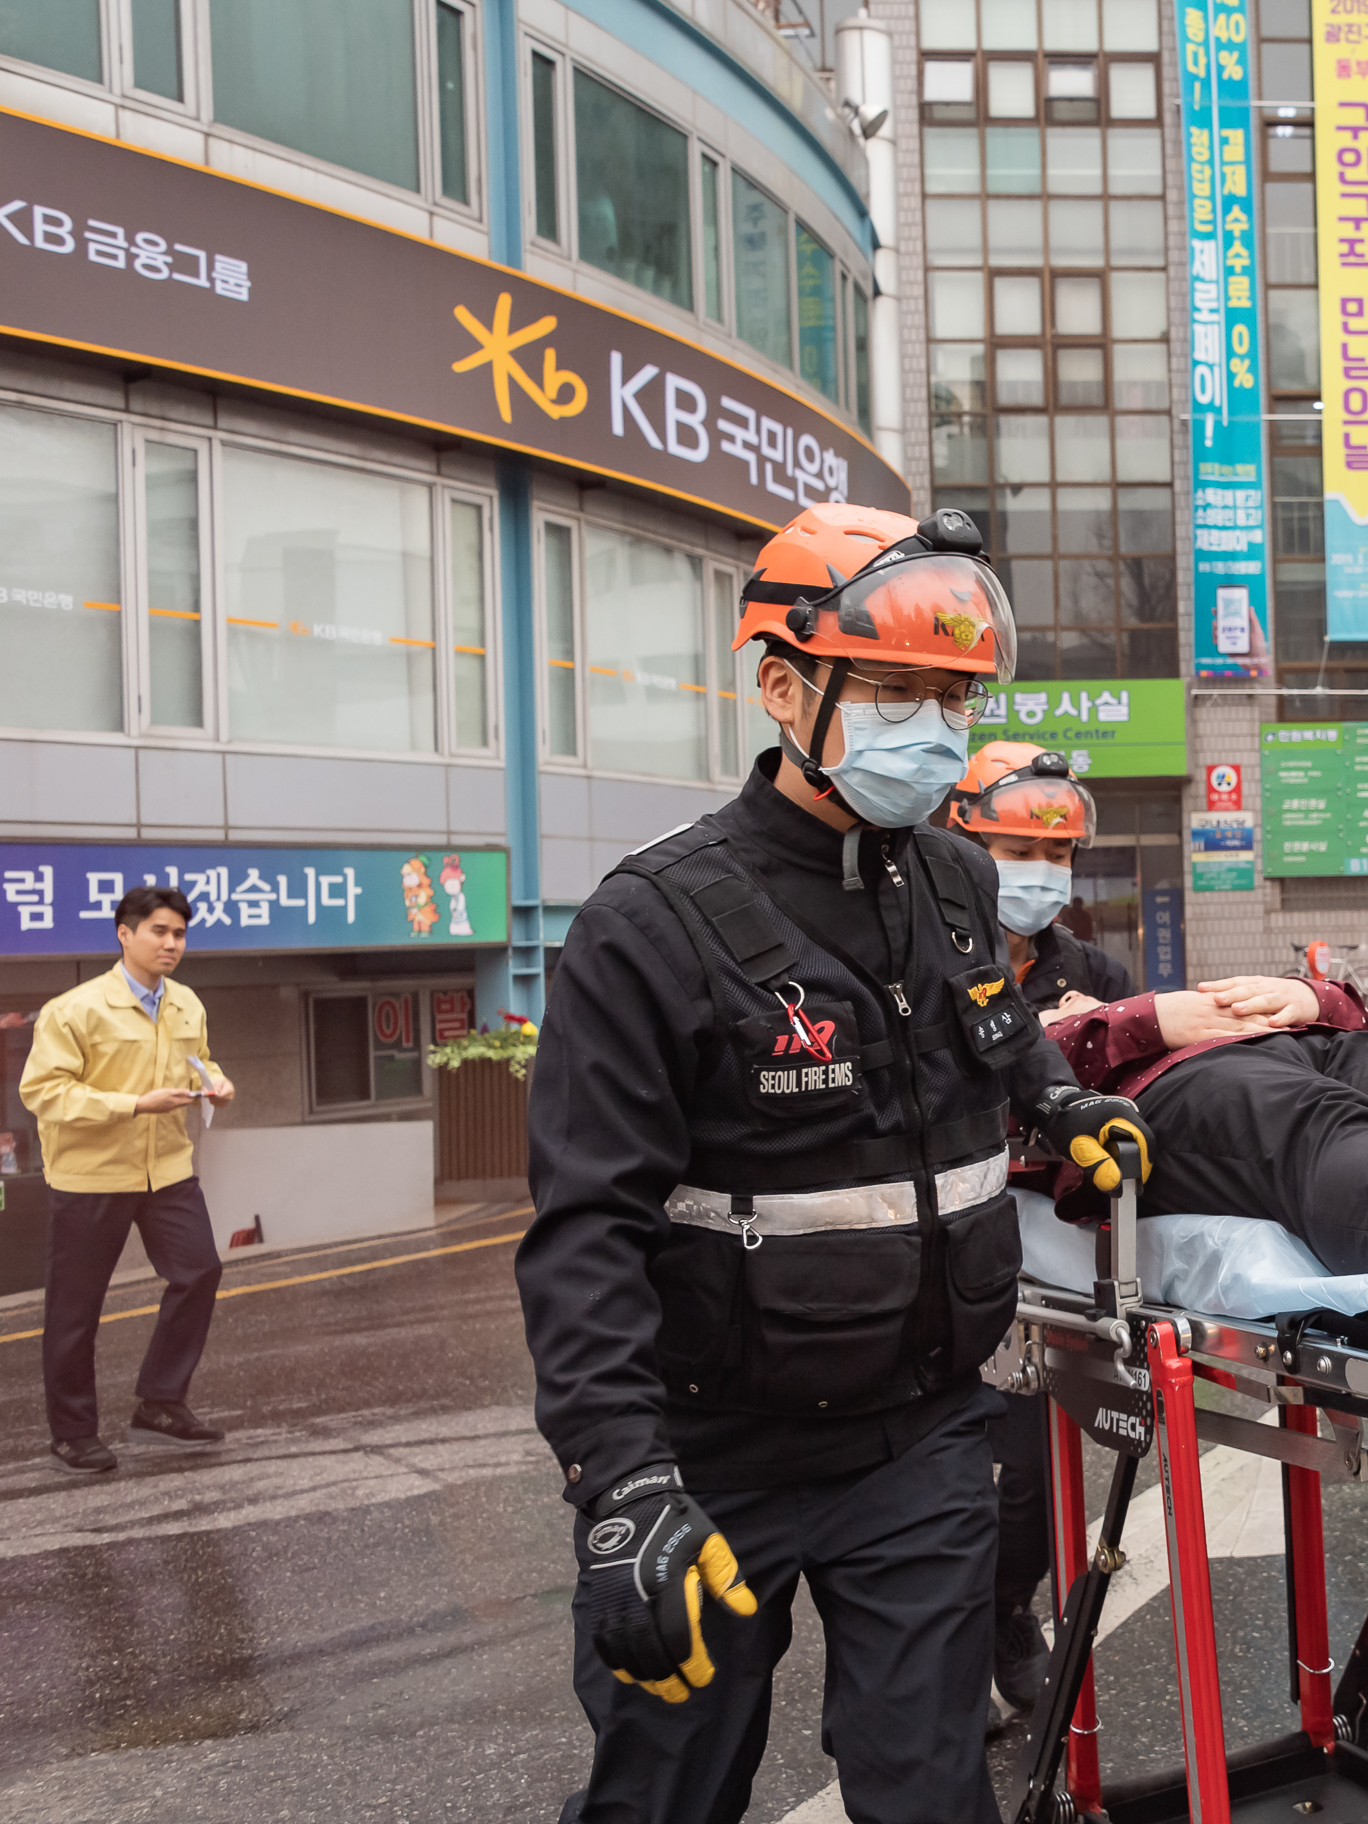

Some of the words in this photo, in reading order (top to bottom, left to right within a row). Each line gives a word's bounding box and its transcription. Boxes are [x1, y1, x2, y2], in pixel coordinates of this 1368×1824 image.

[1219, 128, 1247, 197] 결제
[83, 216, 252, 303] 금융그룹
[1224, 204, 1252, 308] 수수료
[1230, 323, 1255, 389] 0%
[610, 350, 710, 463] KB
[716, 394, 849, 509] 국민은행
[1002, 728, 1059, 743] Service
[1063, 726, 1116, 741] Center
[760, 1070, 799, 1094] SEOUL
[801, 1065, 826, 1091] FIRE
[828, 1061, 853, 1088] EMS
[1094, 1407, 1146, 1441] AUTECH
[612, 1471, 672, 1501] Caiman
